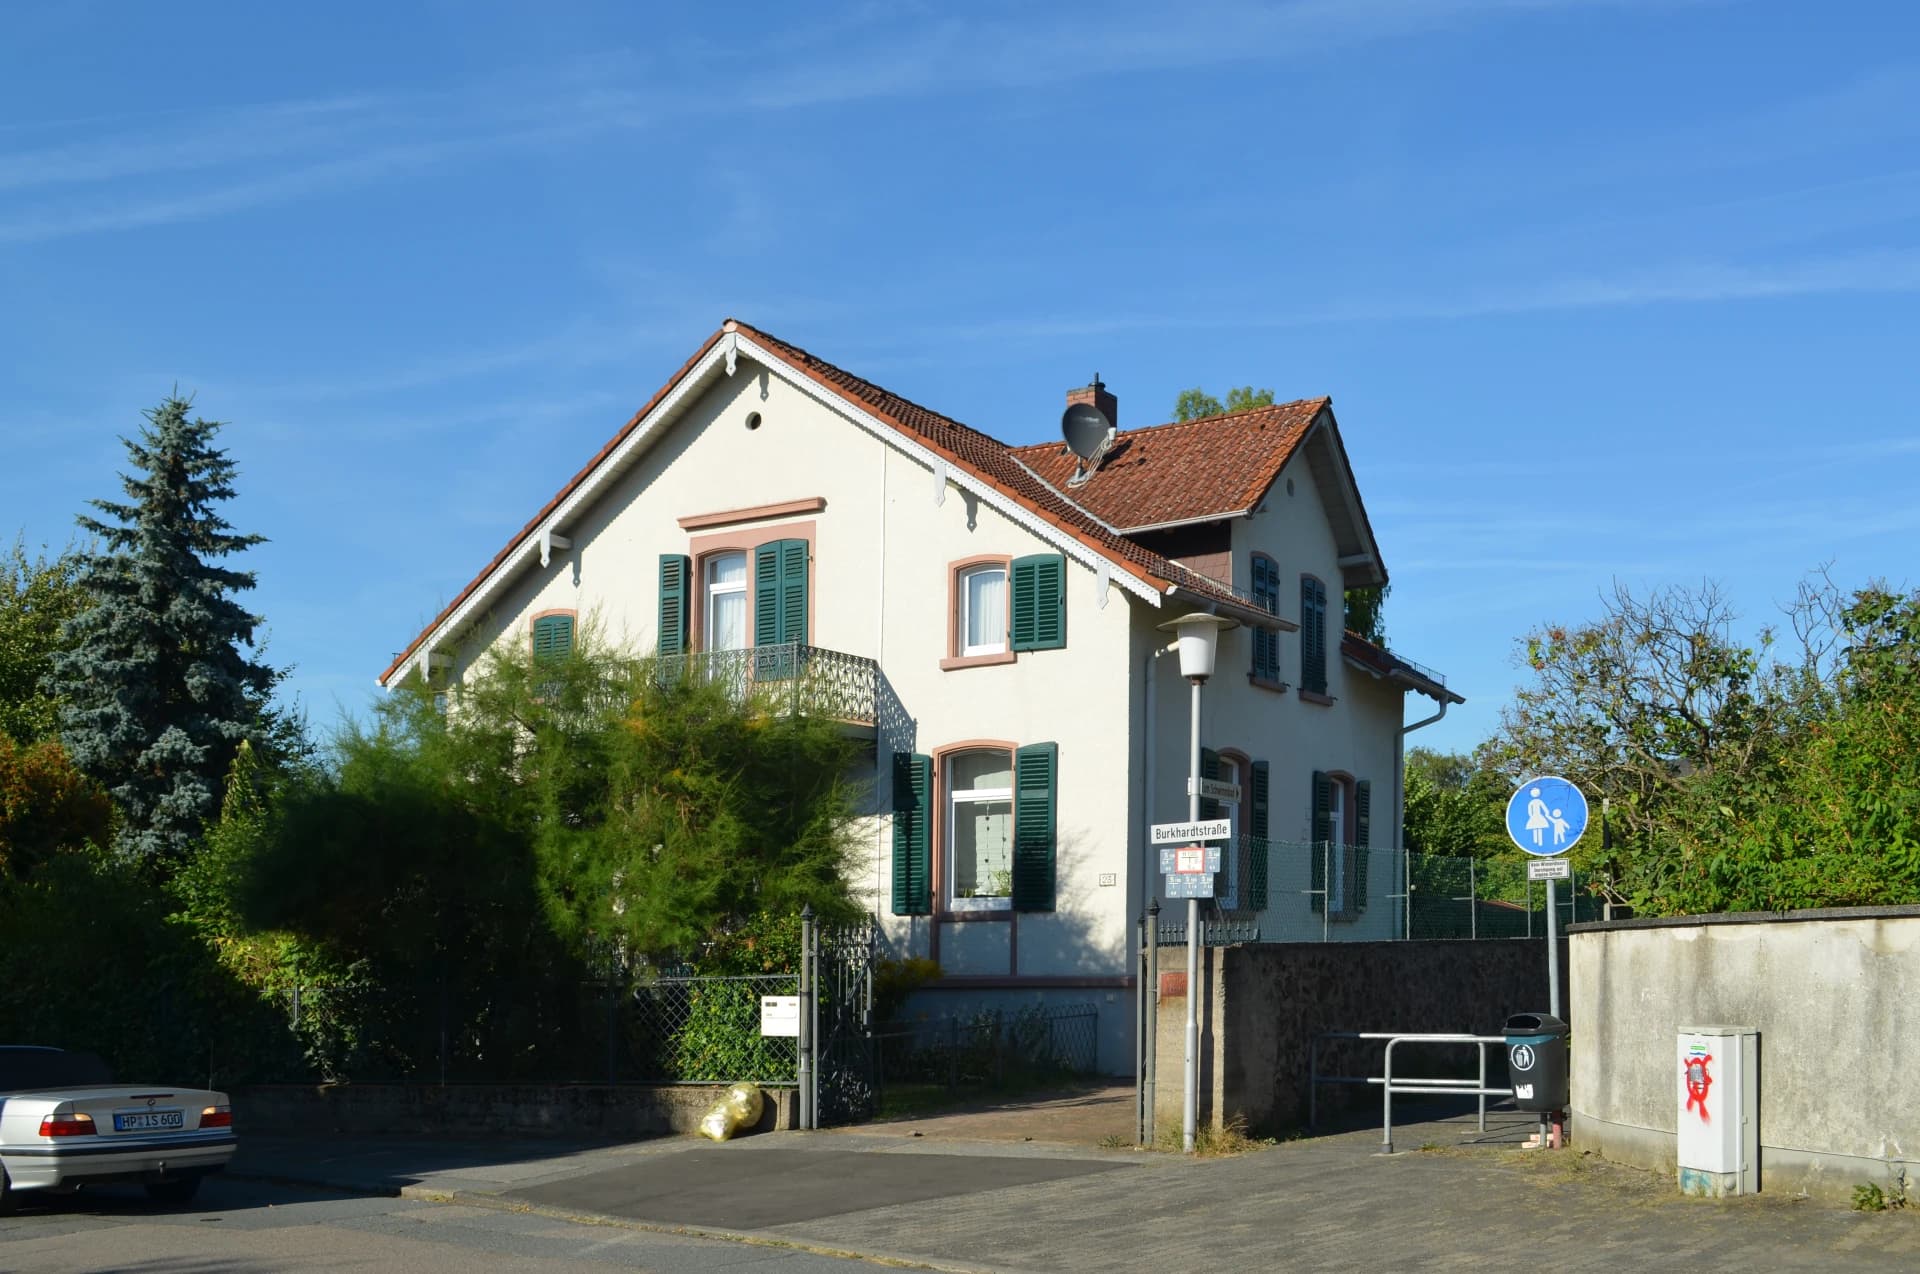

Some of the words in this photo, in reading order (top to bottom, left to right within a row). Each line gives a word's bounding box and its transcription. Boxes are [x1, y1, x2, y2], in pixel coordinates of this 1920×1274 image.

[1156, 824, 1227, 839] Burkhardtstraße
[122, 1116, 136, 1128] HP
[161, 1113, 180, 1125] 600
